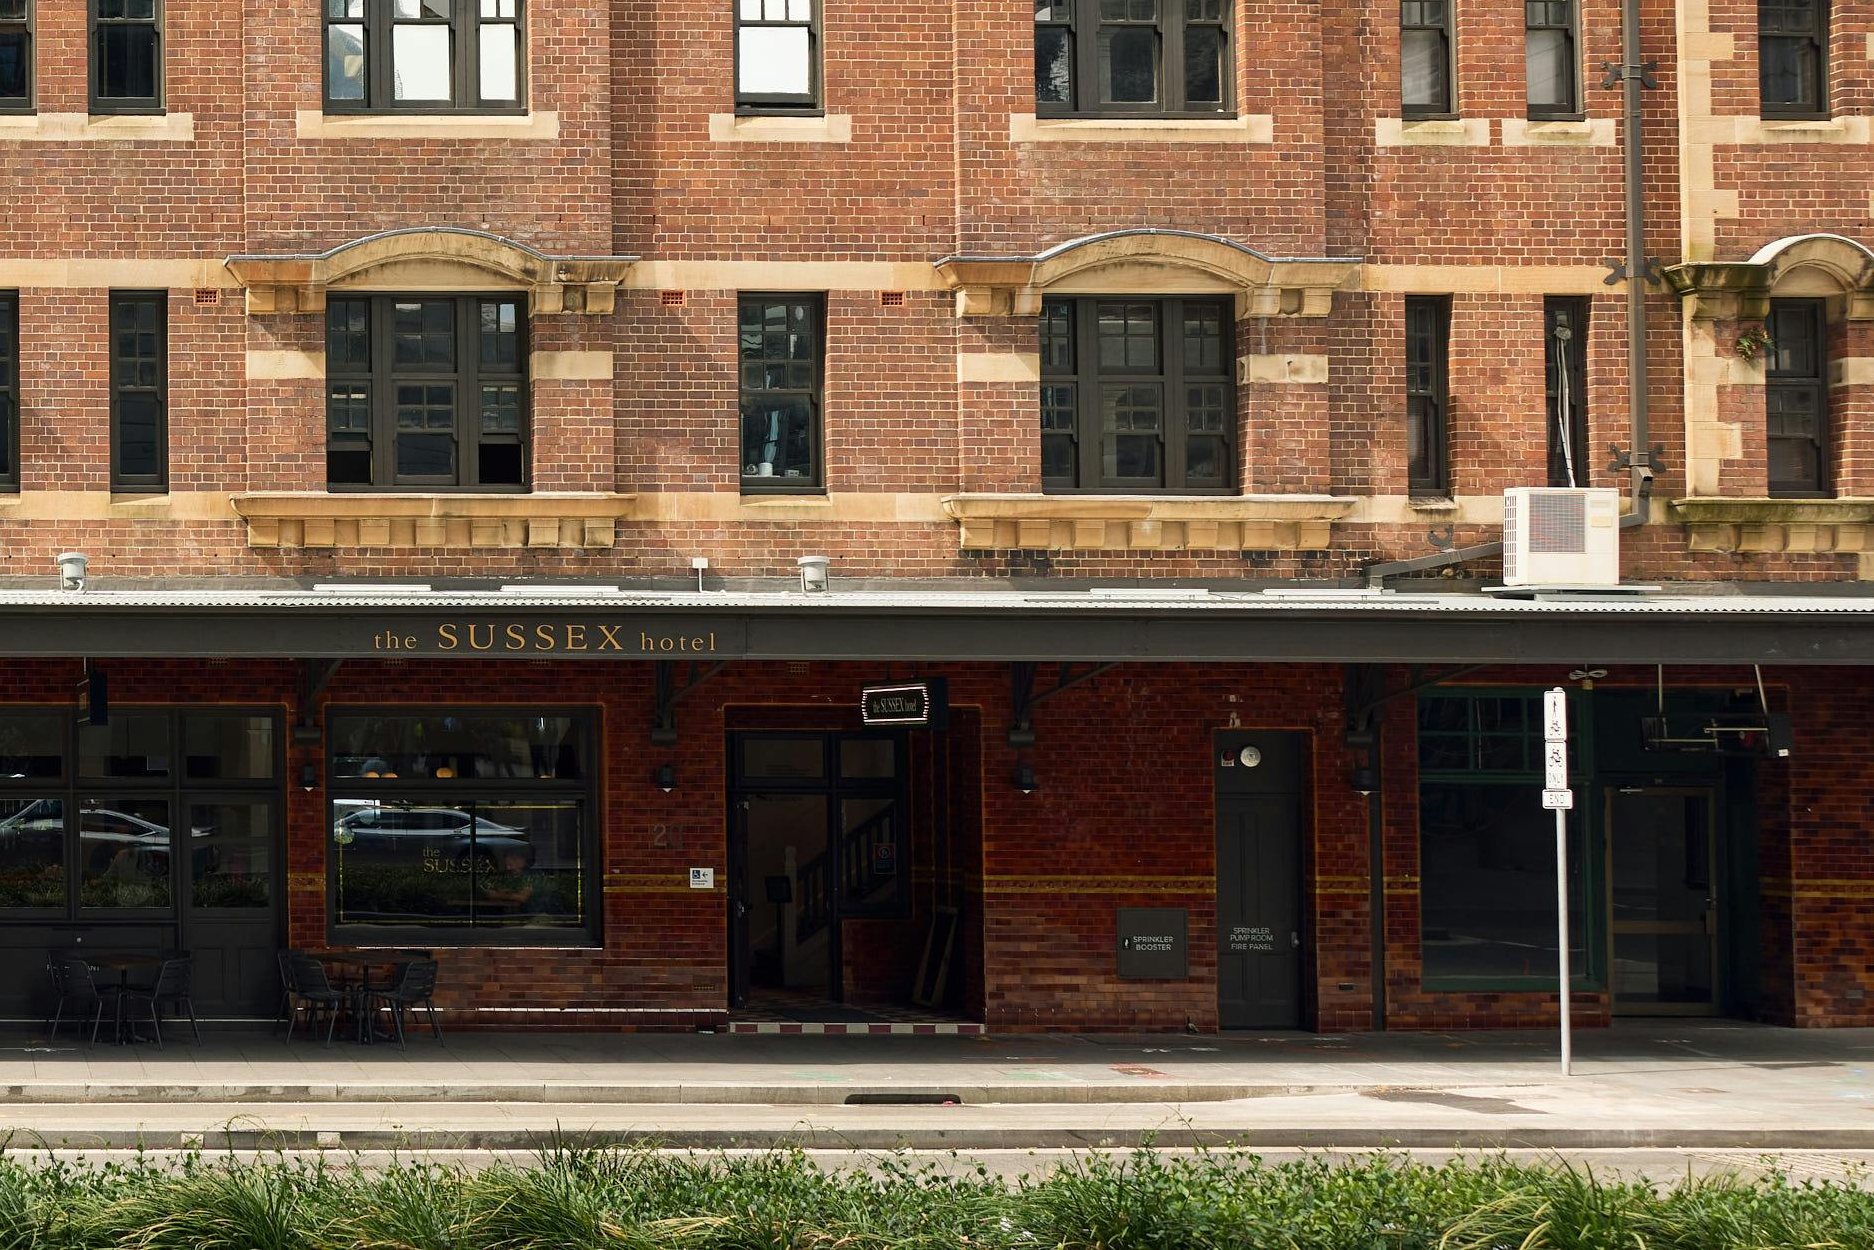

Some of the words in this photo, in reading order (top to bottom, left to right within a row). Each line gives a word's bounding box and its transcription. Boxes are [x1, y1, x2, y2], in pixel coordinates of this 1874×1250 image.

[374, 631, 418, 650] the
[437, 623, 624, 650] SUSSEX
[640, 631, 716, 651] hotel
[881, 697, 904, 712] SUSSEX
[1549, 793, 1565, 804] END
[423, 846, 441, 857] the
[1232, 927, 1270, 935] SPRINKLER
[1132, 935, 1174, 943] SPRINKLER
[1229, 934, 1251, 942] PUMP
[1251, 934, 1274, 942] ROOM
[1135, 943, 1172, 951] BOOSTER
